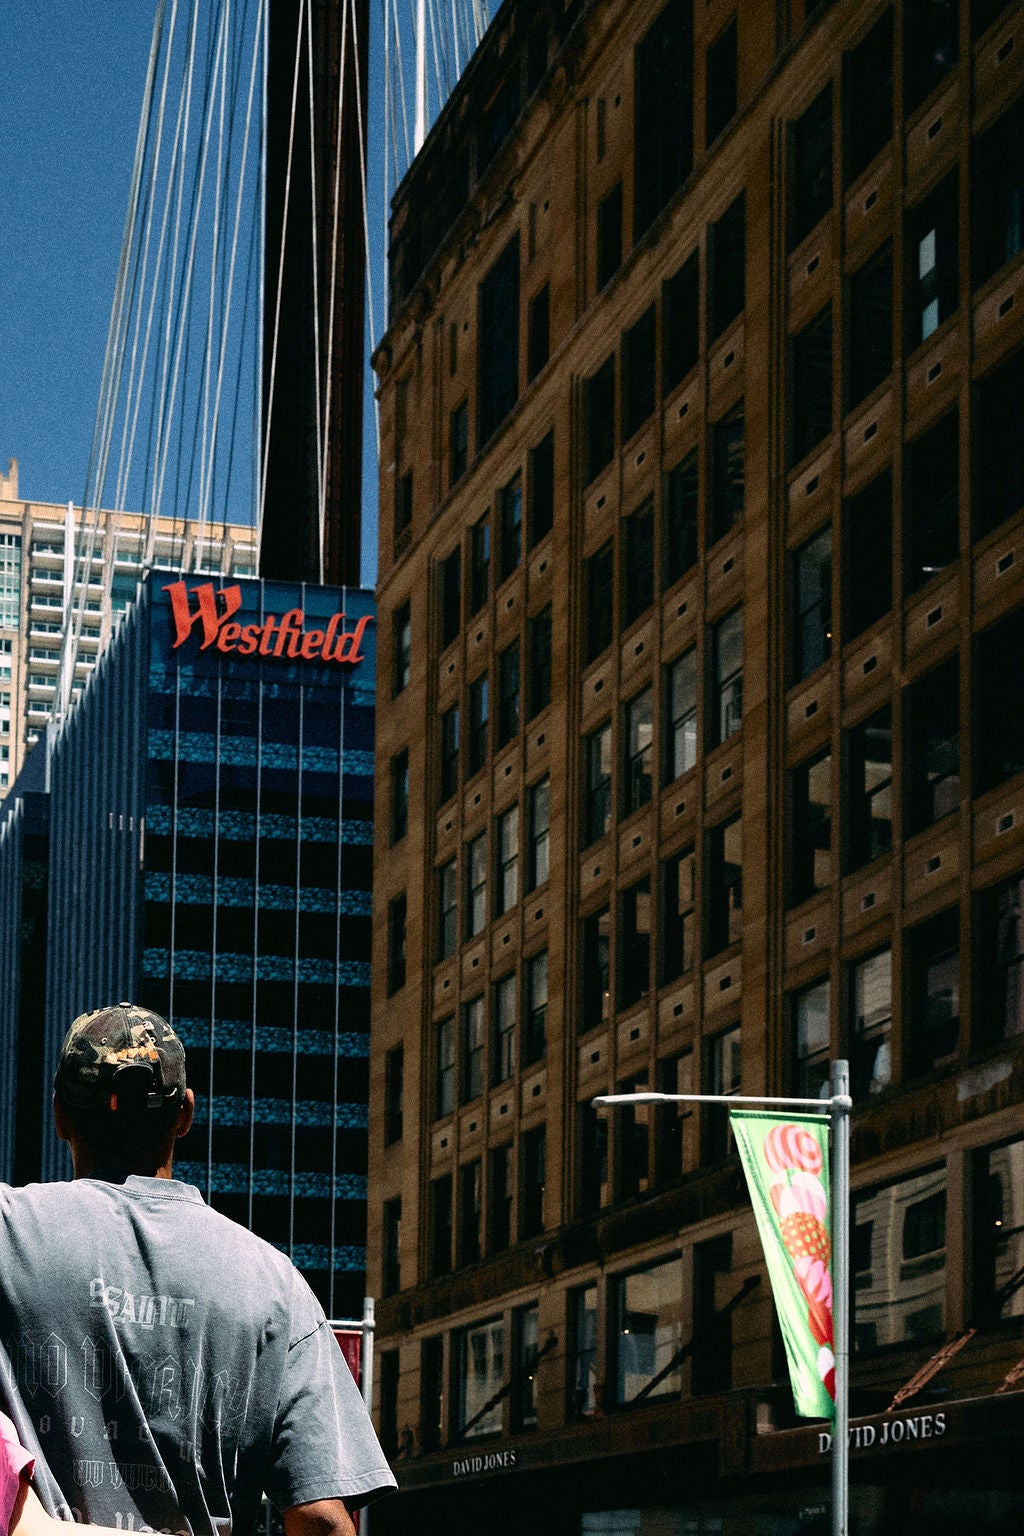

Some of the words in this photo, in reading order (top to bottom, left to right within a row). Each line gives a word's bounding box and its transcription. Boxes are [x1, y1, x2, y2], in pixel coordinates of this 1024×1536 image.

[161, 580, 374, 664] Westfield
[818, 1425, 876, 1453] DID
[880, 1413, 946, 1444] JONES
[453, 1457, 482, 1476] DAVID
[483, 1450, 516, 1471] JONES
